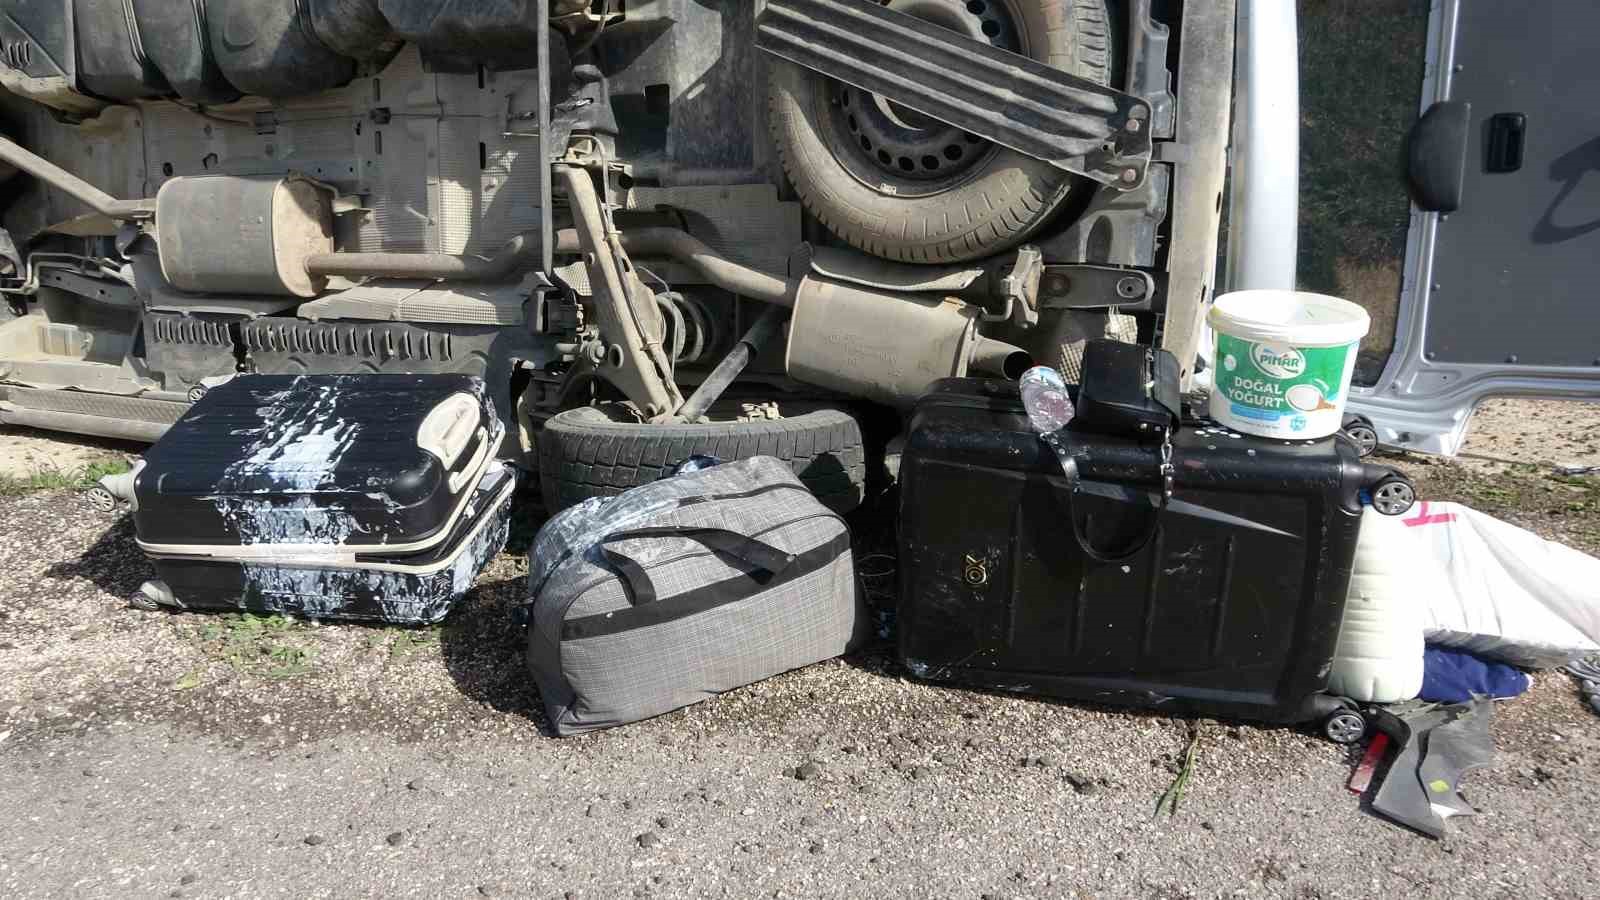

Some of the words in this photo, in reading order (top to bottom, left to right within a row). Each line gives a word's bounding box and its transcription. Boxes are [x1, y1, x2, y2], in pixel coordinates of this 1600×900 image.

[1259, 354, 1299, 367] PINAR
[1235, 376, 1281, 395] DOĞAL
[1229, 388, 1284, 408] YOĞURT
